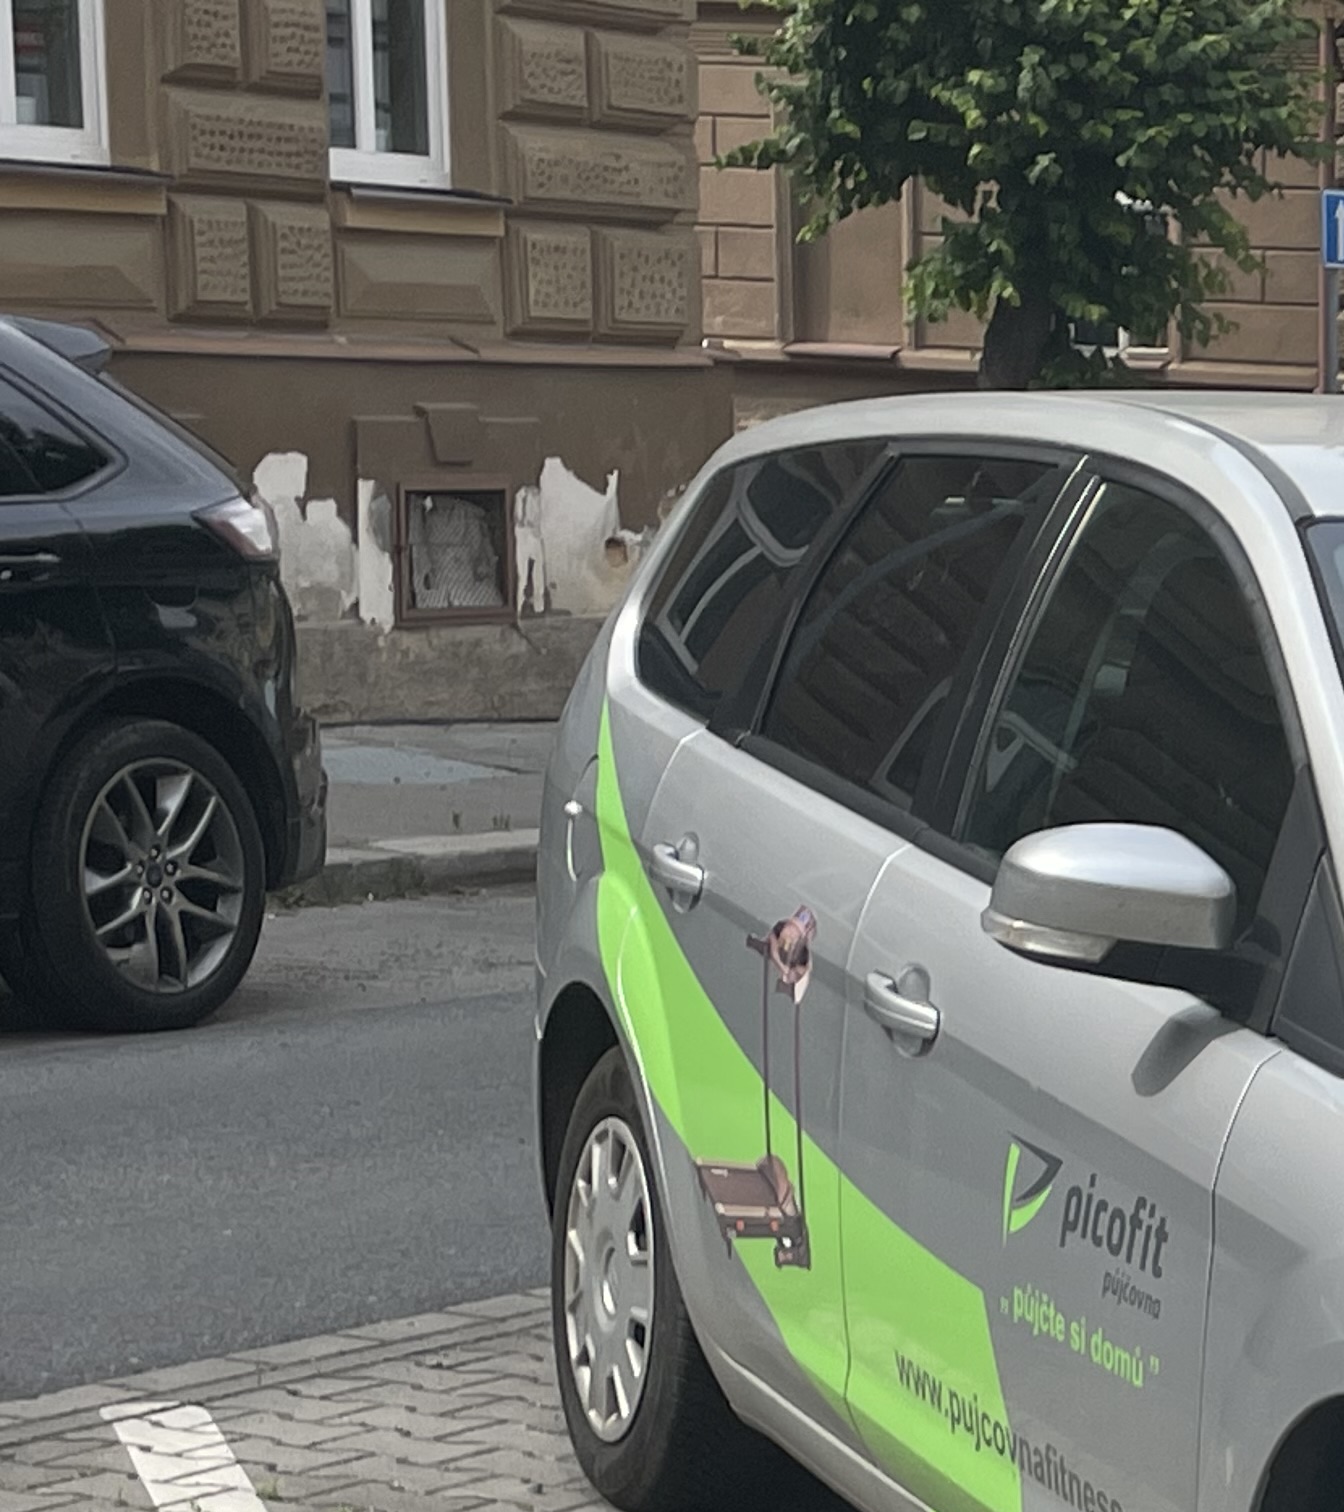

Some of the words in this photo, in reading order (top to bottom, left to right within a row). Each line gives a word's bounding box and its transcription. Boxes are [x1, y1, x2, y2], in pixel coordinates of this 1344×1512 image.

[1060, 1173, 1168, 1279] picofit
[1102, 1267, 1161, 1320] půjčovna
[1070, 1315, 1087, 1354] si
